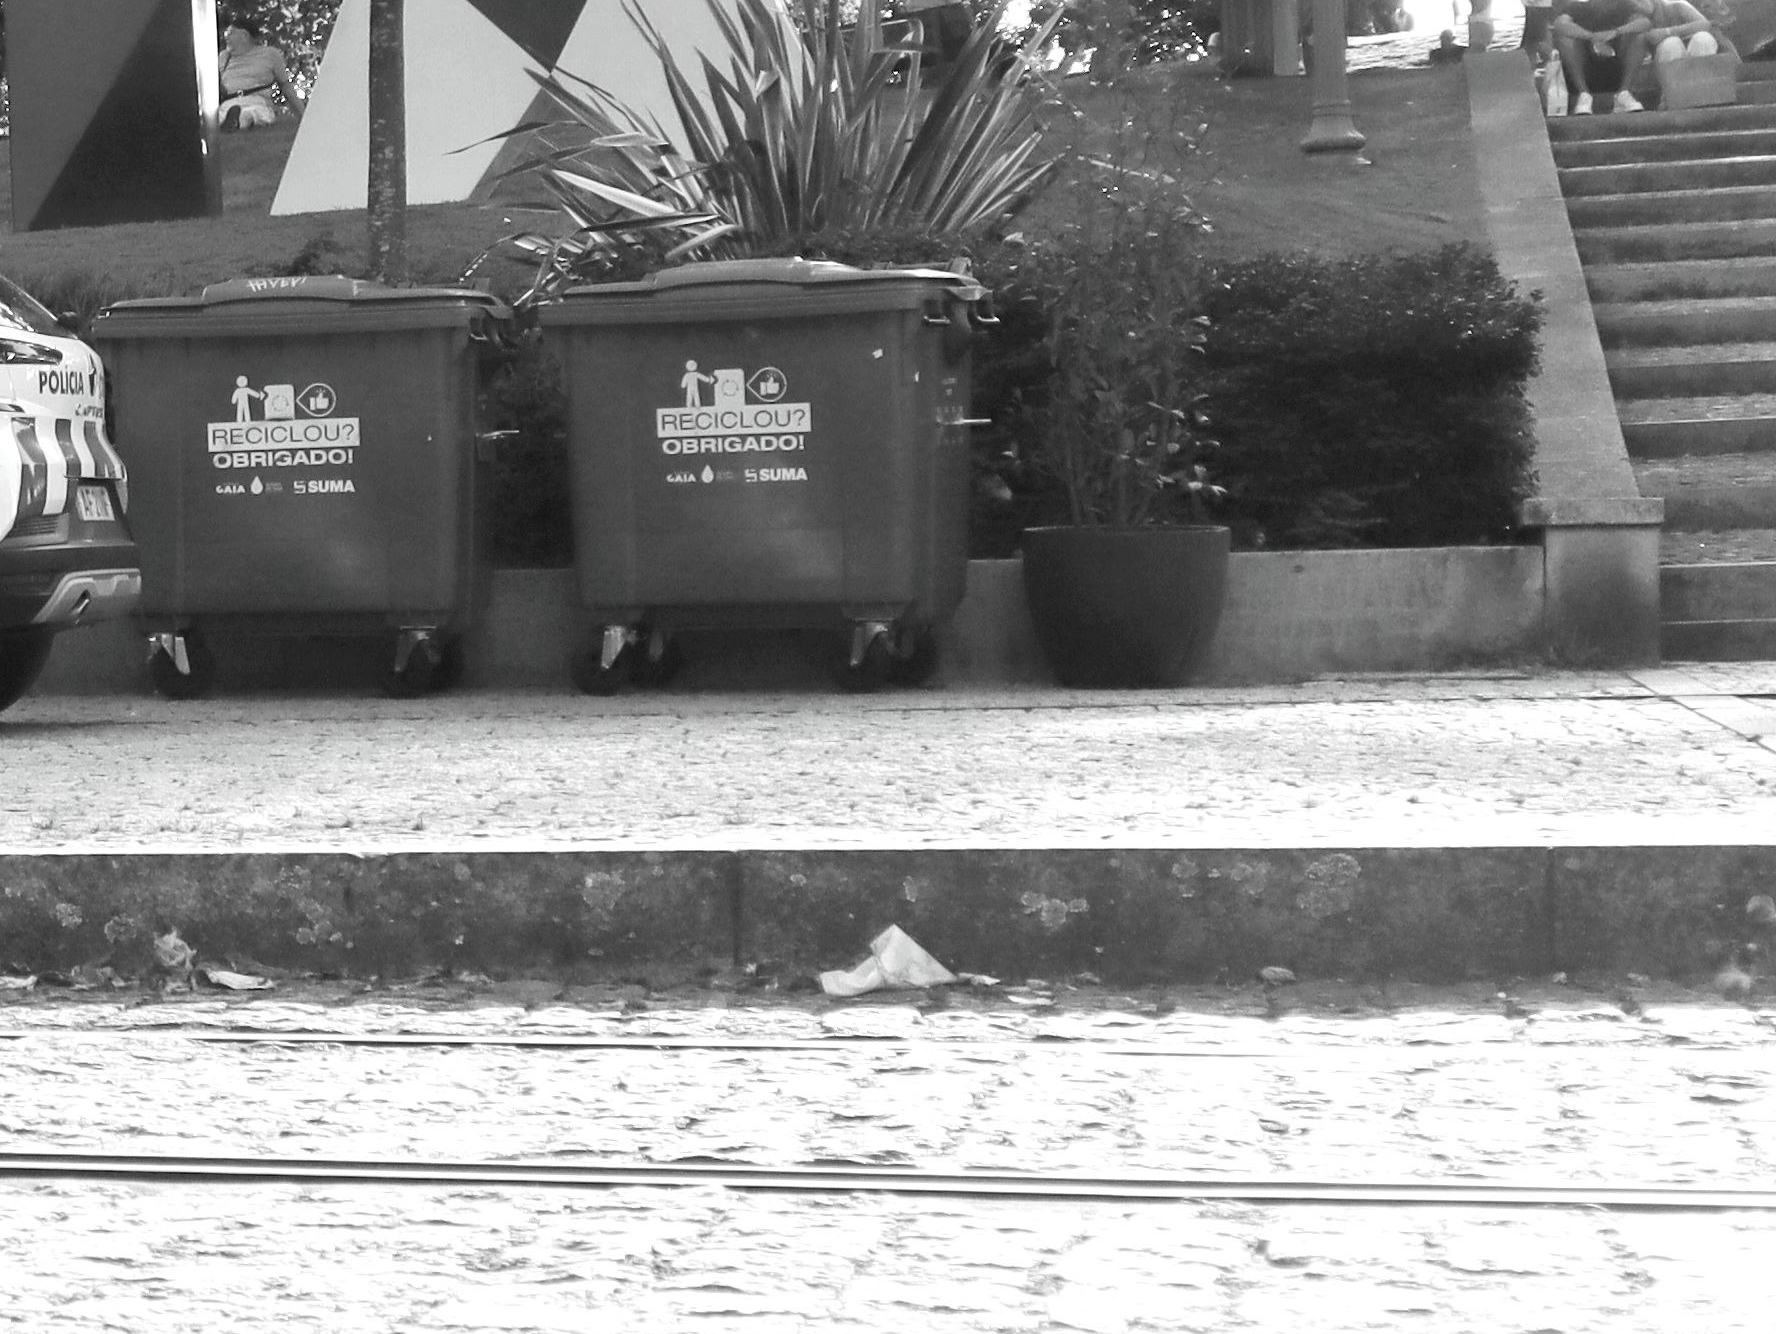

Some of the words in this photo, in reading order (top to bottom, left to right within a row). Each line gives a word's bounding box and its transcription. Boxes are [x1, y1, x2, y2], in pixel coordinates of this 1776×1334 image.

[39, 366, 84, 396] POLÍCIA
[661, 409, 806, 431] RECICLOU?
[212, 424, 355, 446] RECICLOU?
[662, 434, 805, 455] OBRIGADO!
[212, 449, 354, 468] OBRIGADO!
[666, 474, 697, 483] GAIA
[759, 468, 808, 482] SUMA
[215, 485, 246, 494] GAIA
[308, 480, 356, 493] SUMA
